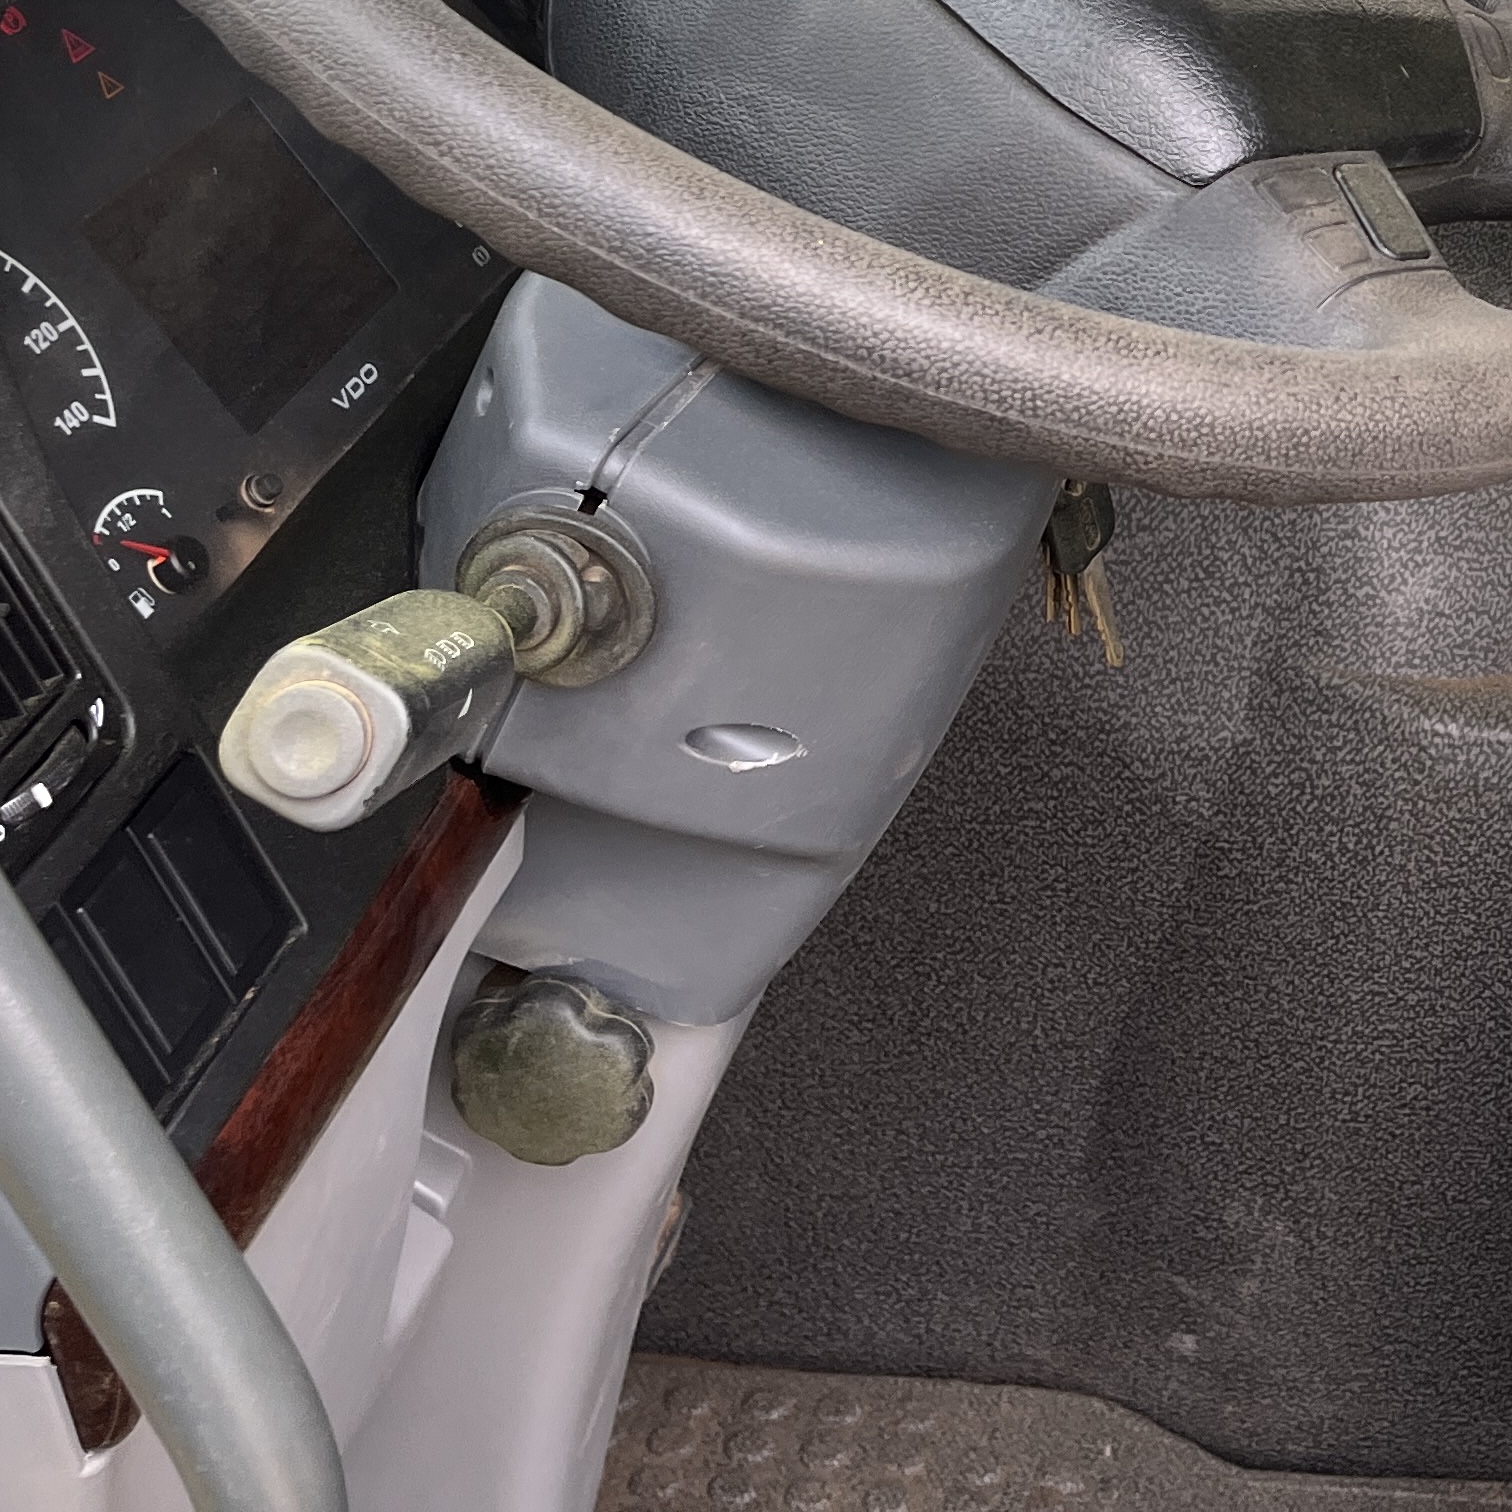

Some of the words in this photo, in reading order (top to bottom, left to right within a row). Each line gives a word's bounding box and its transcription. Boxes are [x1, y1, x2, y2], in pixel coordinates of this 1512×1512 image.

[23, 321, 59, 355] 120
[330, 363, 379, 410] VDO
[53, 400, 90, 436] 140
[107, 558, 121, 572] 0
